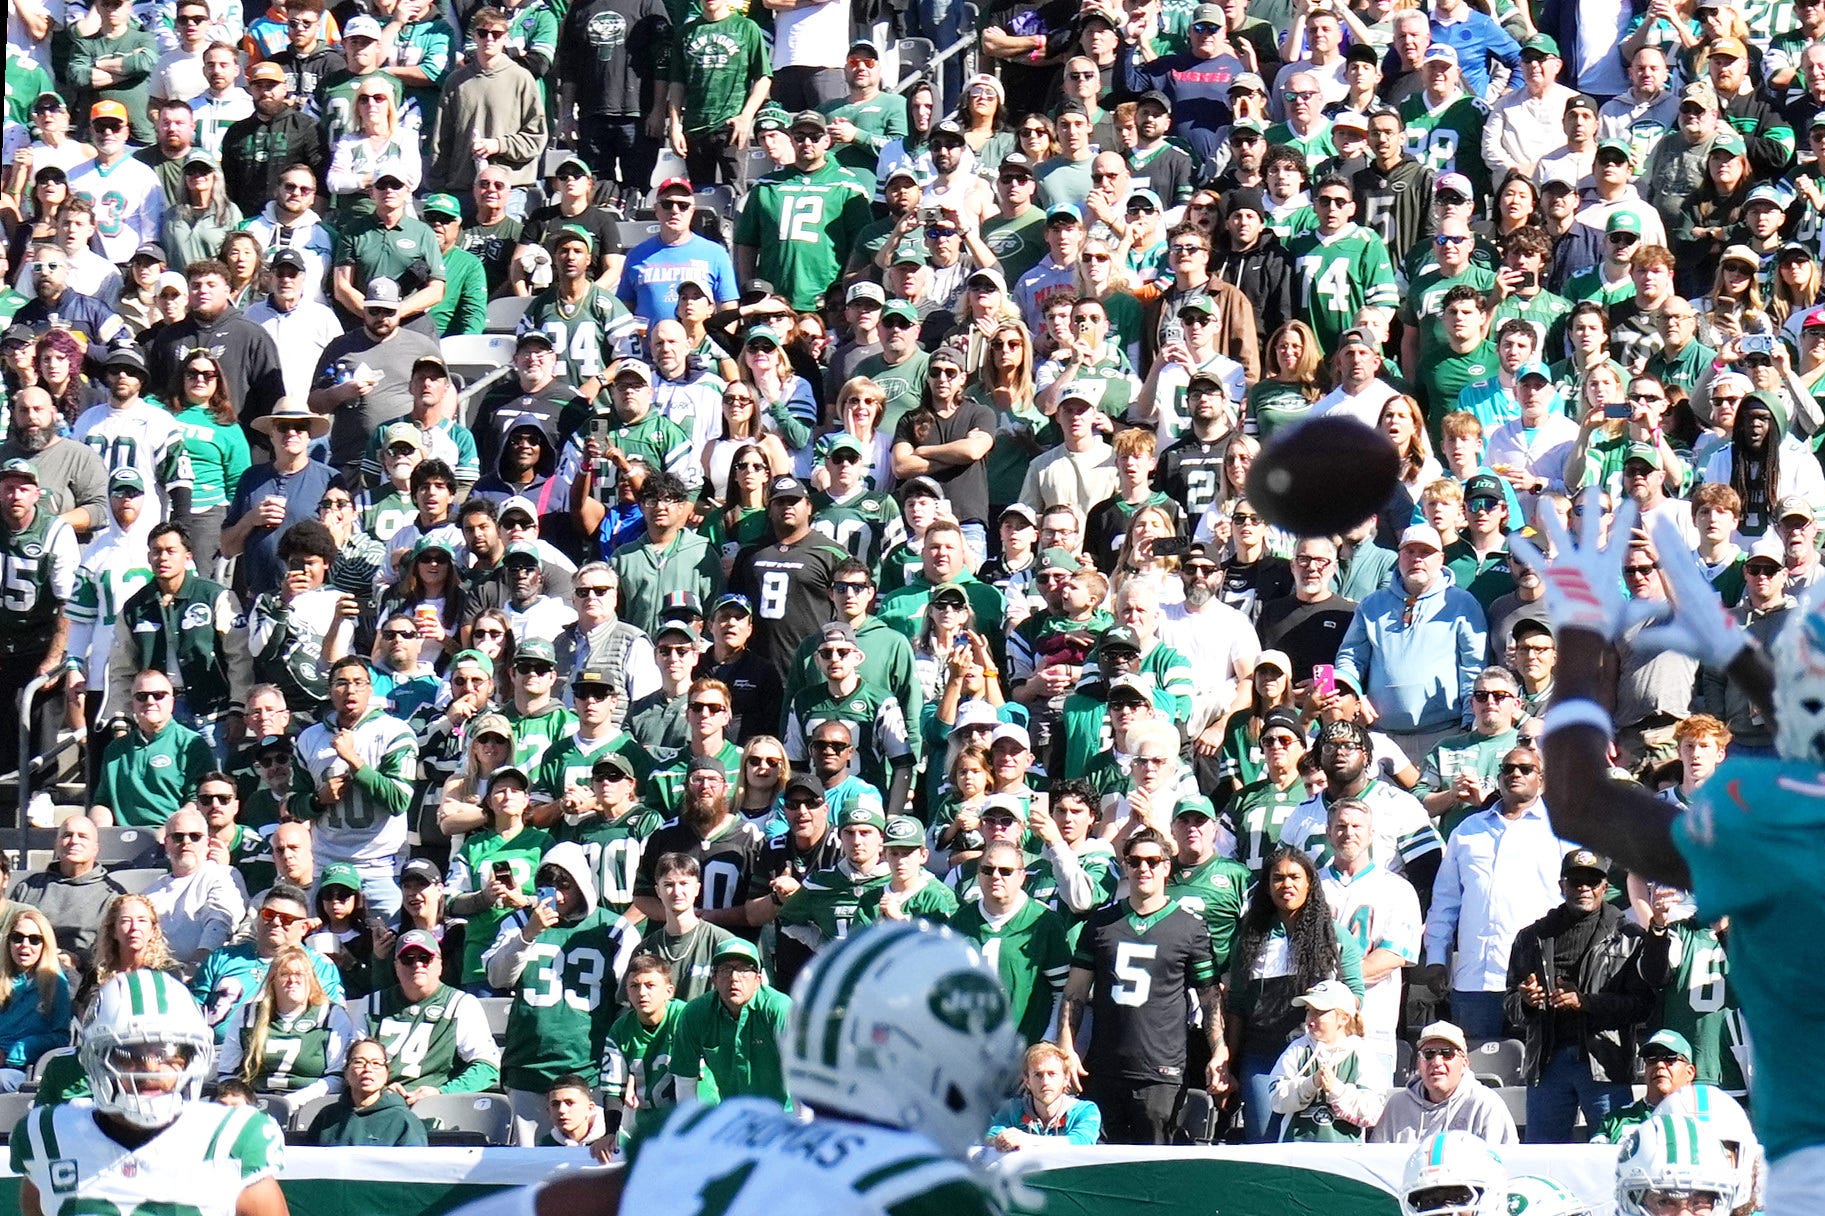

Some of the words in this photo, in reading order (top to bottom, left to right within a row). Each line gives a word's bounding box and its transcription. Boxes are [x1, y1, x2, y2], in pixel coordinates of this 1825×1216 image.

[685, 38, 709, 59] NEW
[708, 36, 737, 56] YORK
[779, 196, 825, 242] 12
[1366, 197, 1394, 243] 5
[1299, 255, 1350, 313] 74
[552, 322, 600, 375] 24
[628, 334, 642, 356] 2
[1187, 468, 1214, 514] 2
[1473, 480, 1500, 492] JETS
[759, 571, 789, 619] 8
[521, 945, 601, 1011] 33
[1111, 943, 1158, 1006] 5
[264, 1039, 304, 1089] 7
[723, 1110, 864, 1167] THOMAS
